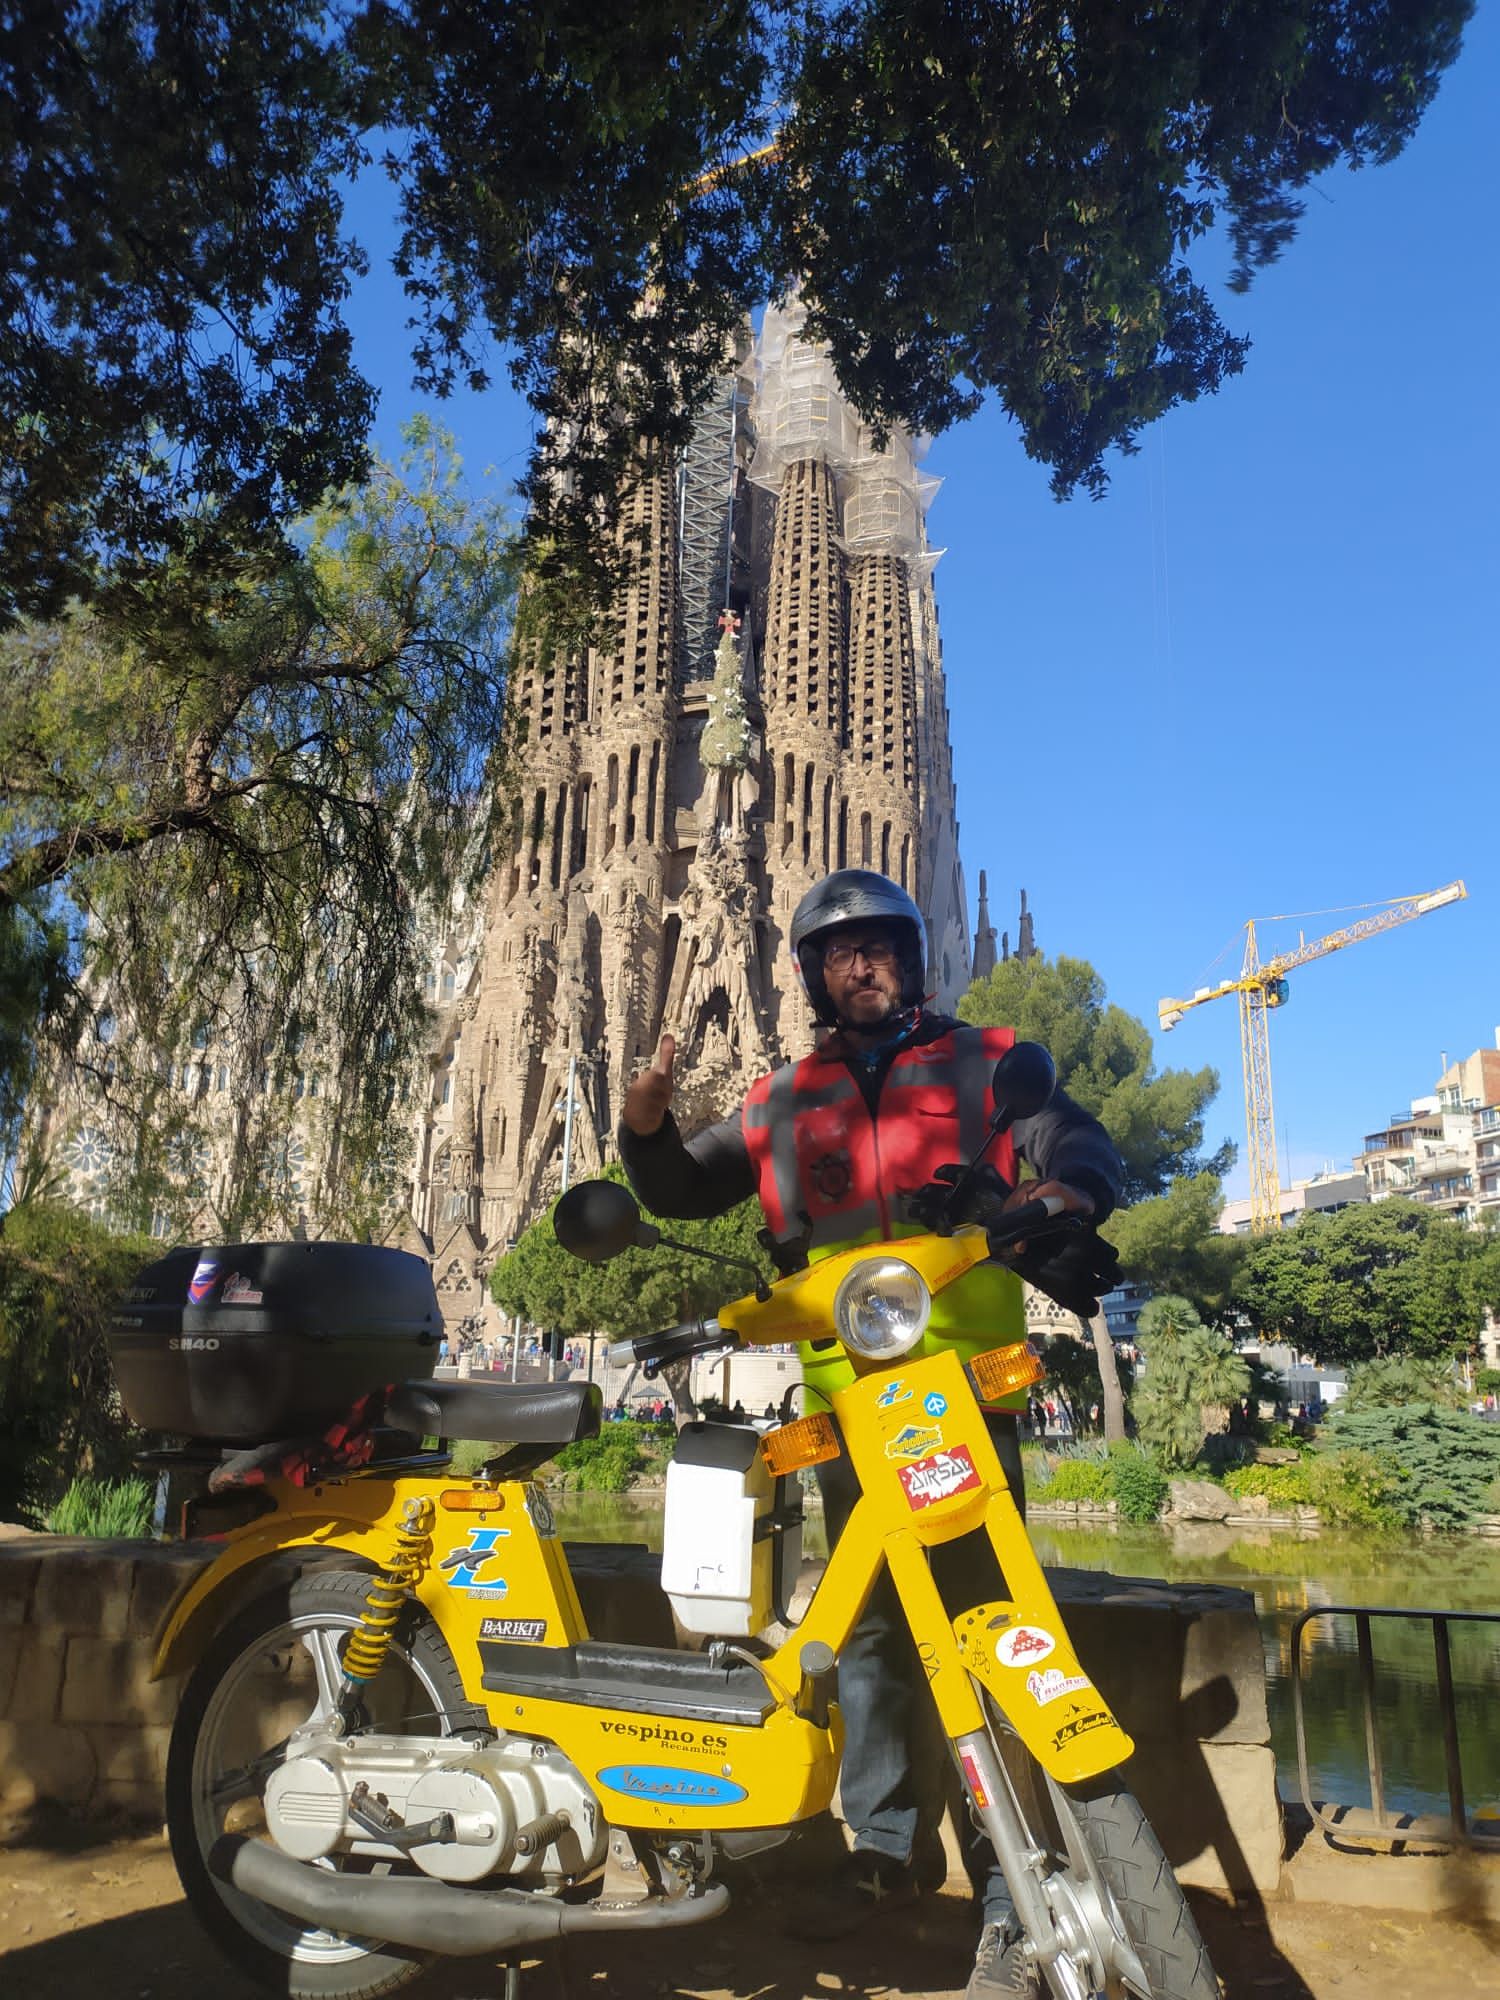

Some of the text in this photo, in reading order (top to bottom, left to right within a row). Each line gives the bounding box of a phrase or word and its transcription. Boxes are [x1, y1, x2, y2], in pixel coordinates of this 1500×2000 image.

[169, 1338, 220, 1350] SH40
[912, 1456, 971, 1491] AIRSAL
[482, 1619, 545, 1637] BARIKIT
[600, 1721, 695, 1743] vespino
[661, 1741, 726, 1756] Recambios
[622, 1769, 720, 1797] Vespino
